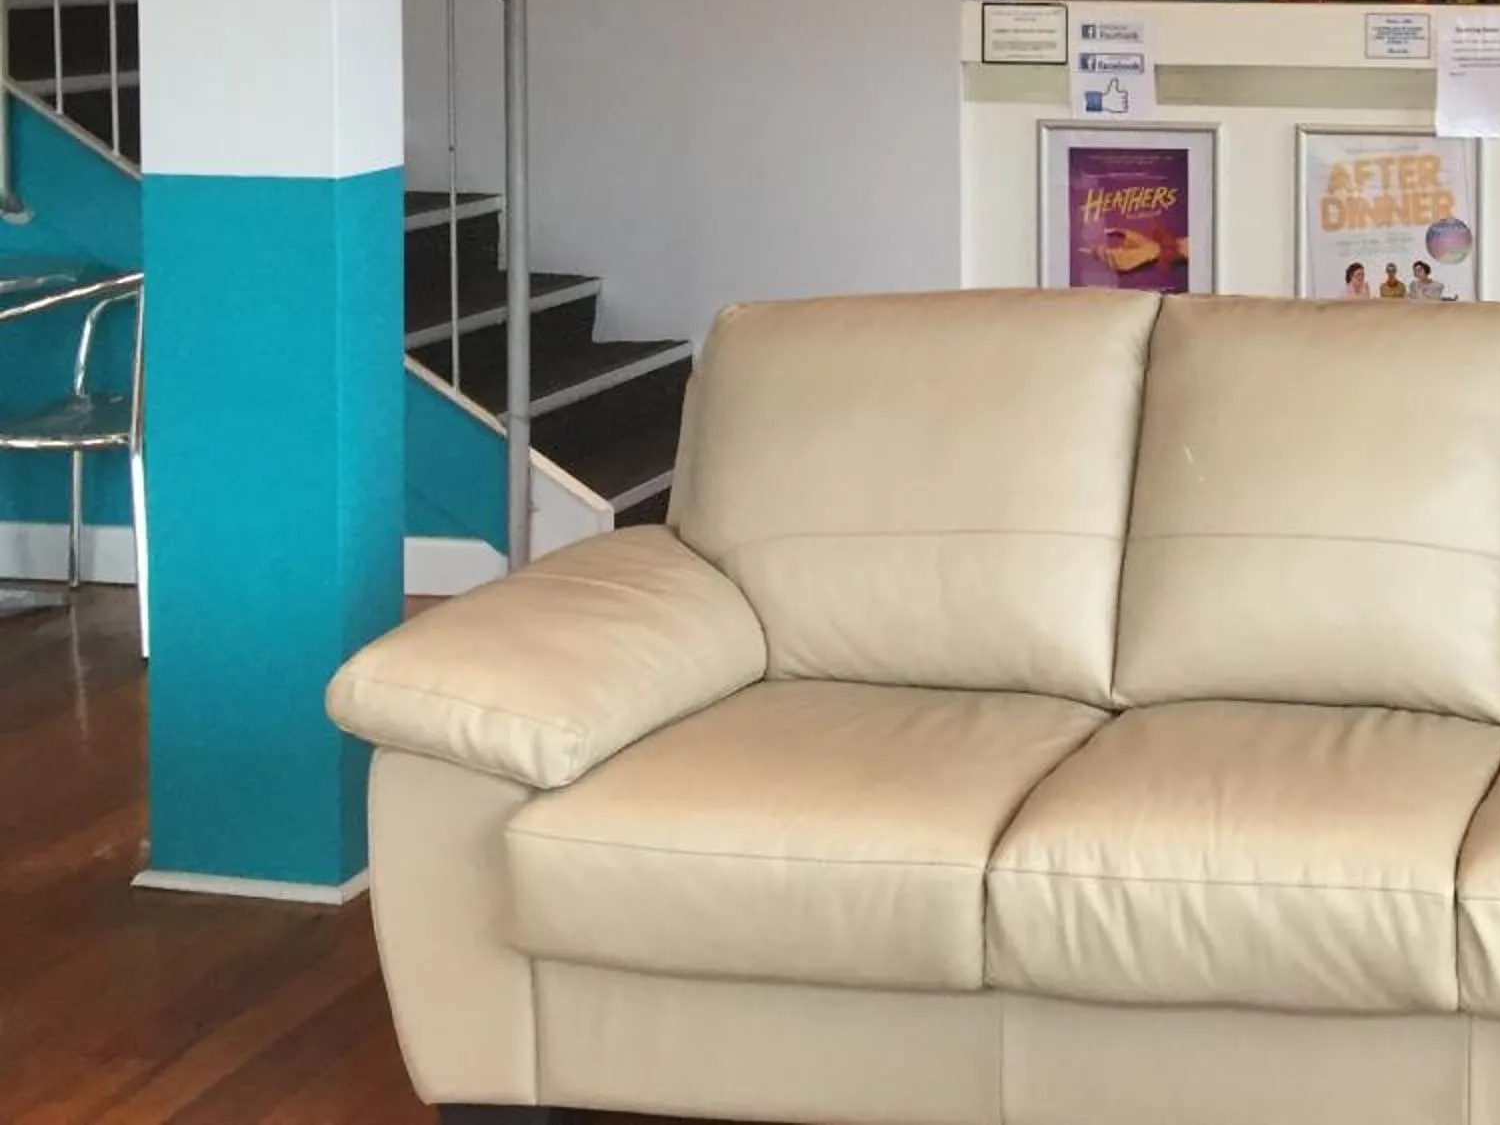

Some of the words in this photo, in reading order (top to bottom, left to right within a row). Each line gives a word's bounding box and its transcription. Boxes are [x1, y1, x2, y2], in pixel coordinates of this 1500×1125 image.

[1327, 155, 1442, 194] AFTER
[1082, 186, 1179, 223] HEATHERS
[1320, 190, 1456, 232] DINNER
